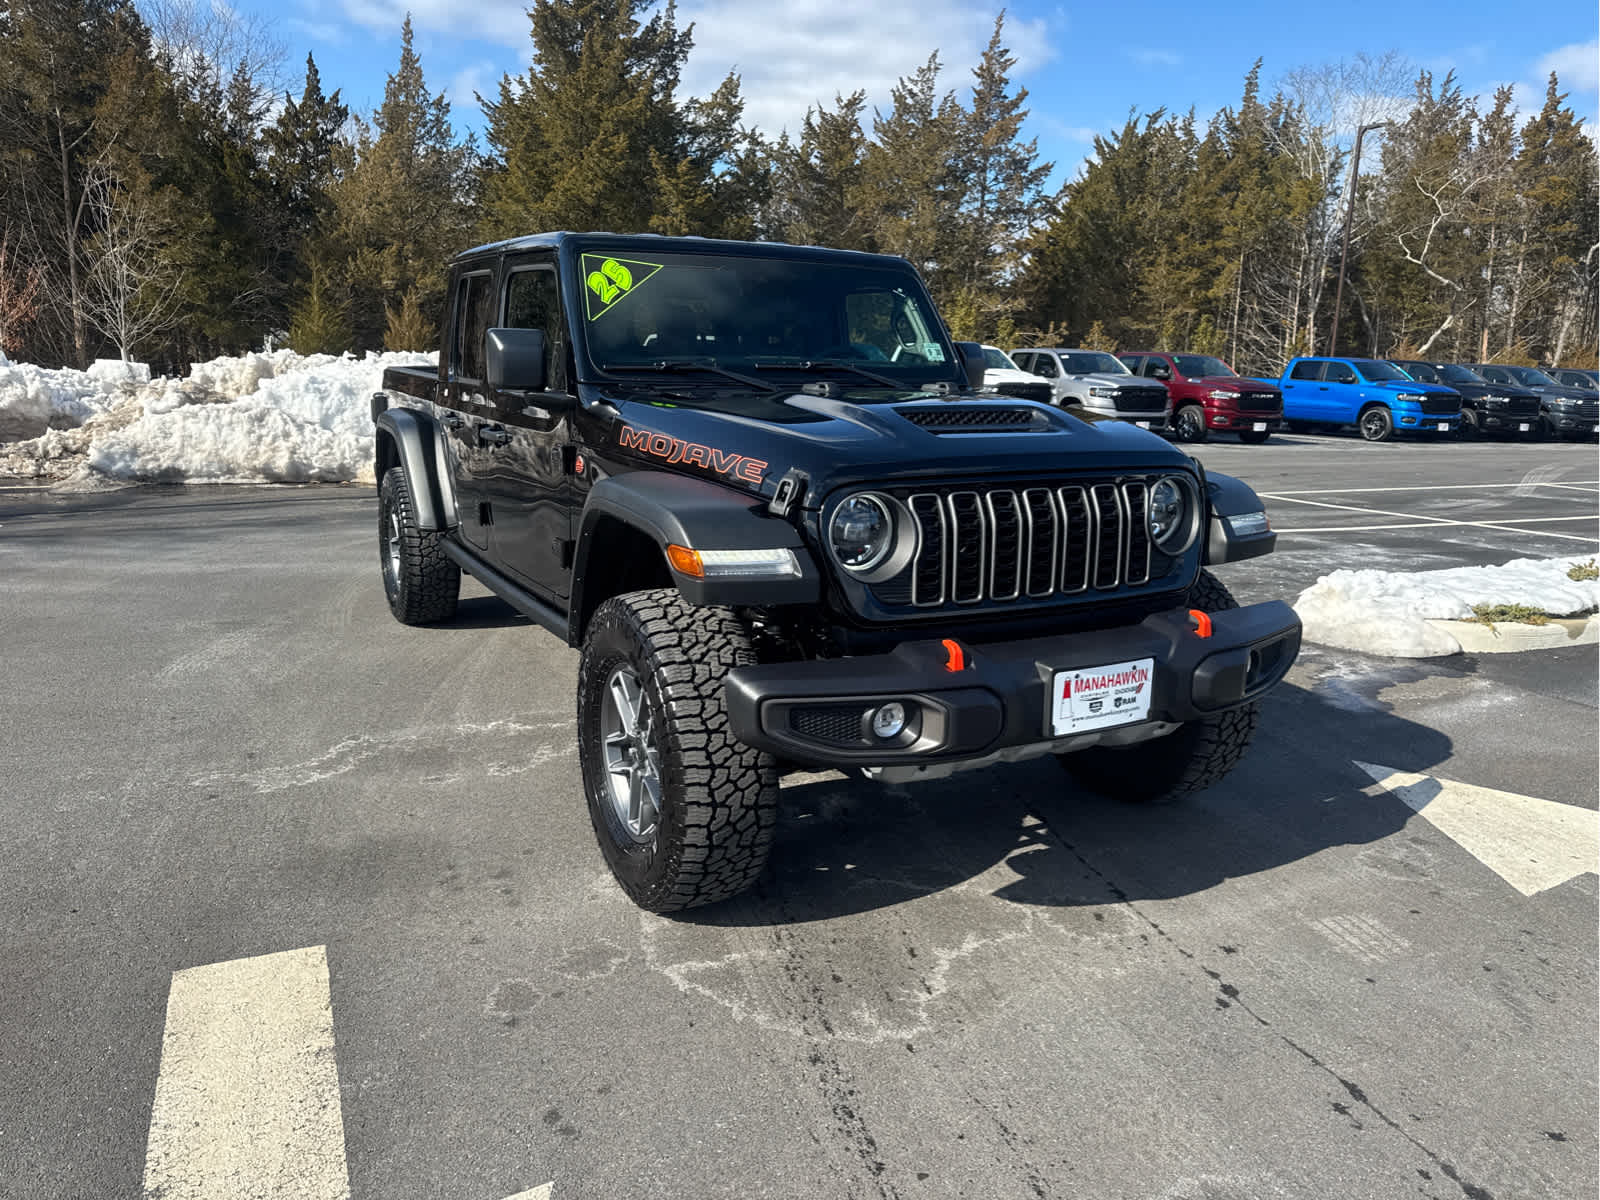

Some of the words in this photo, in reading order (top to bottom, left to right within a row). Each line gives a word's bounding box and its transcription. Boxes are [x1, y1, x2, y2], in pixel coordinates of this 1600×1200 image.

[587, 259, 632, 304] 25
[619, 426, 768, 483] MOJAVE
[1074, 668, 1147, 693] MANAHAWKIN
[1122, 696, 1136, 704] RAM
